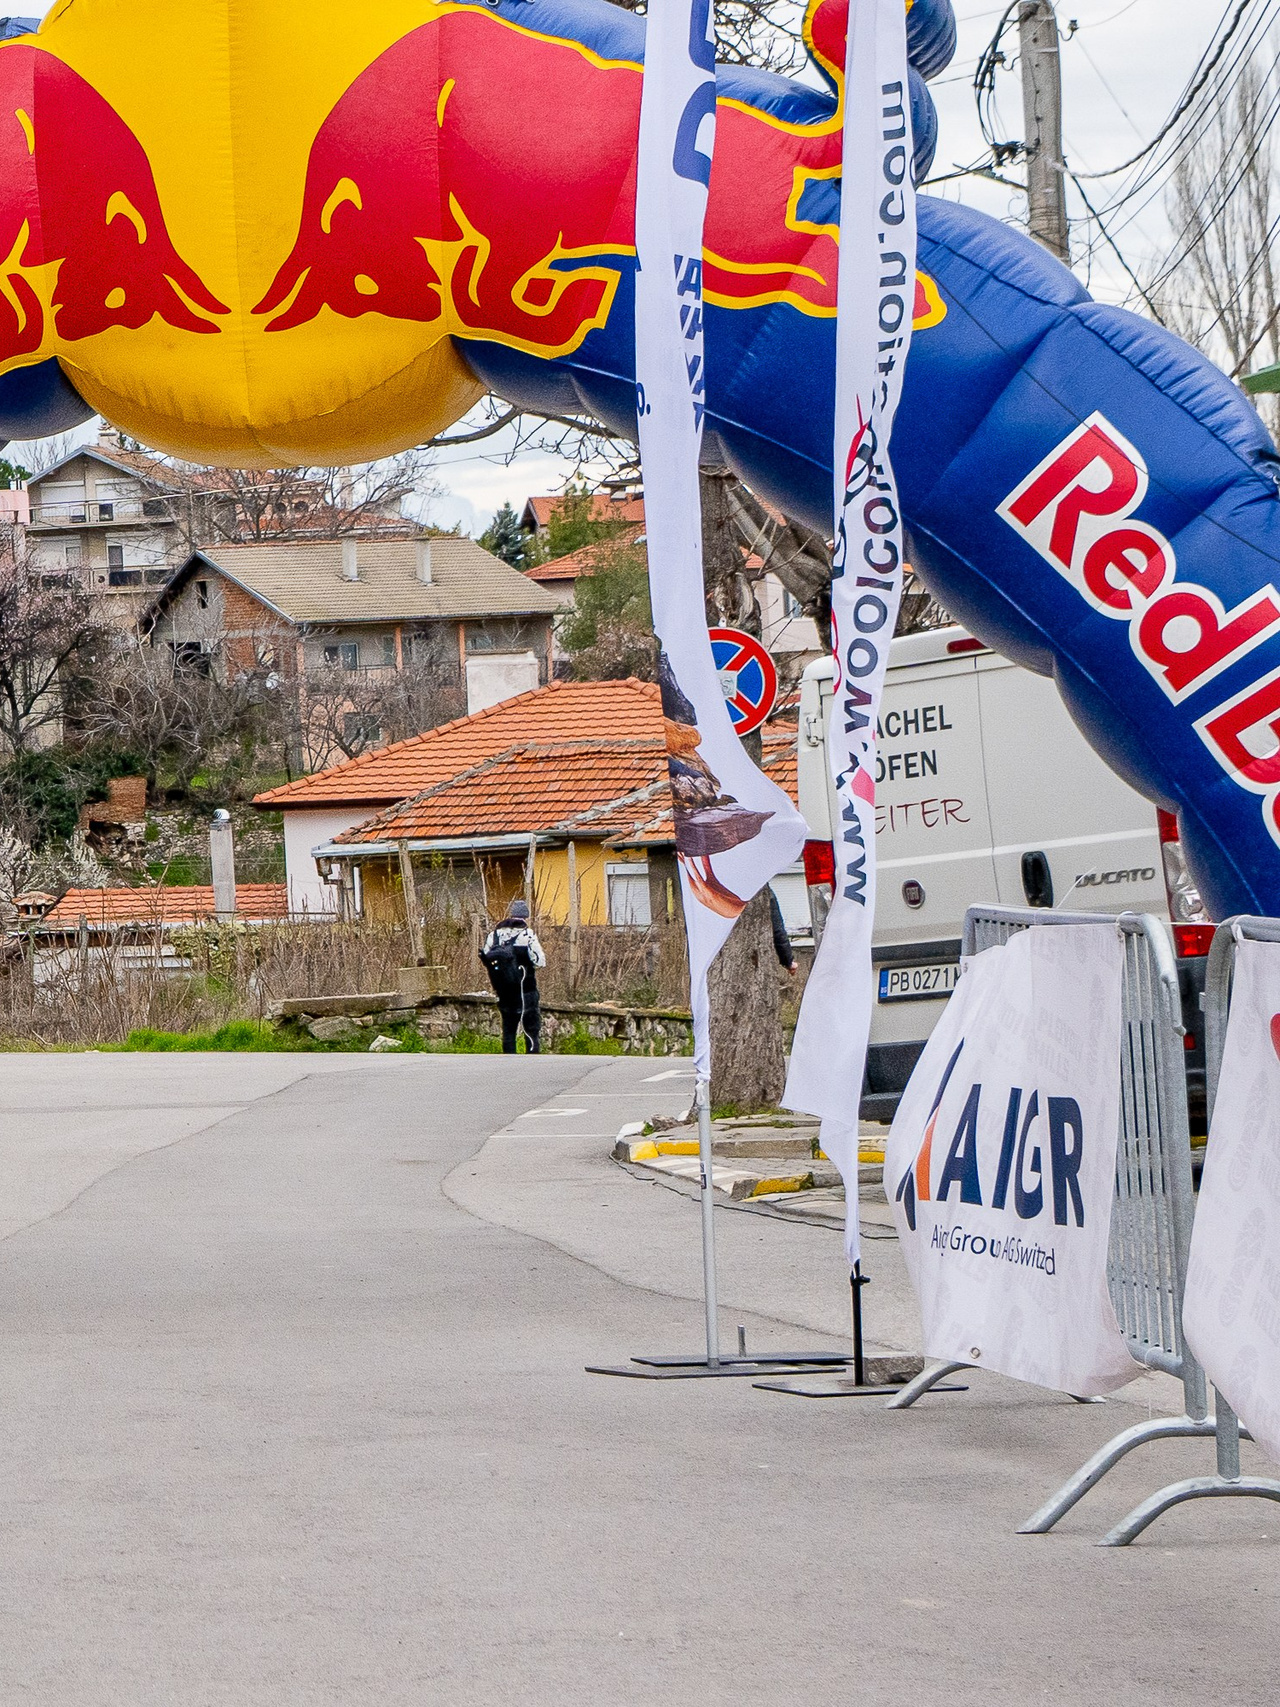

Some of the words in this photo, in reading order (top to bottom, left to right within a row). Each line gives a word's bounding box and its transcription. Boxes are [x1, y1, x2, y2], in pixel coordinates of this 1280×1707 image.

[1075, 867, 1155, 888] DUCATO
[889, 971, 910, 993] PB
[913, 967, 949, 991] 0271
[936, 1083, 1085, 1229] AIGR
